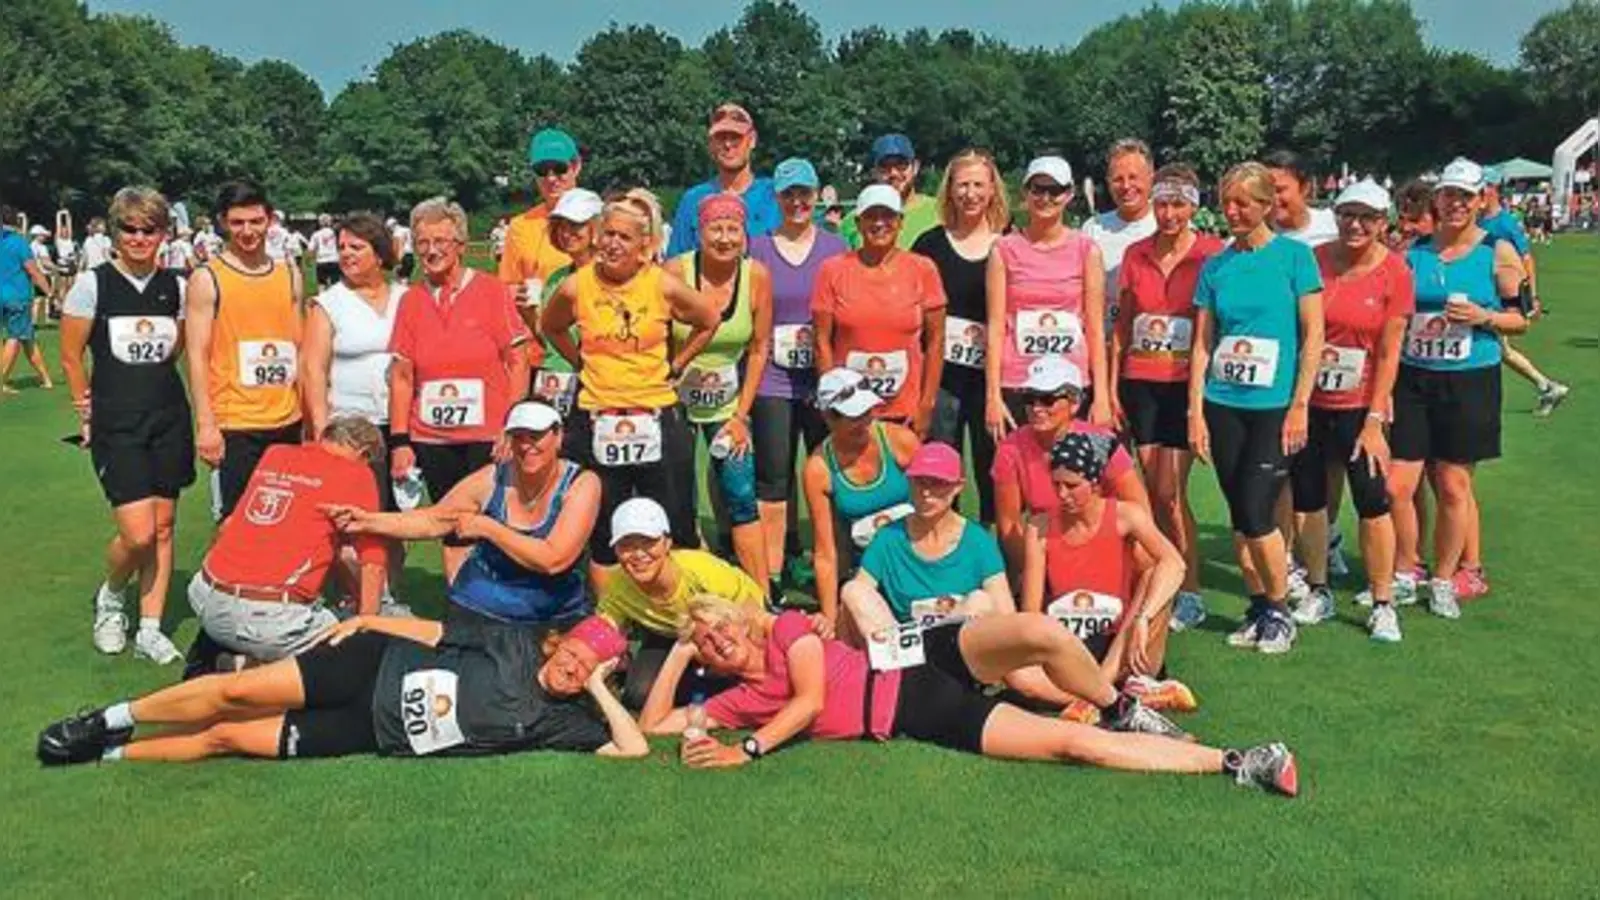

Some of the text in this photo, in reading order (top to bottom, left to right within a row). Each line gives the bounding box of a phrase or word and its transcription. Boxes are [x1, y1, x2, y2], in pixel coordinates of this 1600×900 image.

[127, 341, 164, 361] 924
[1024, 335, 1075, 354] 2922
[1412, 338, 1461, 357] 3114
[255, 364, 288, 385] 929
[1223, 361, 1257, 383] 921
[432, 406, 468, 425] 927
[605, 443, 647, 463] 917
[404, 687, 428, 736] 920
